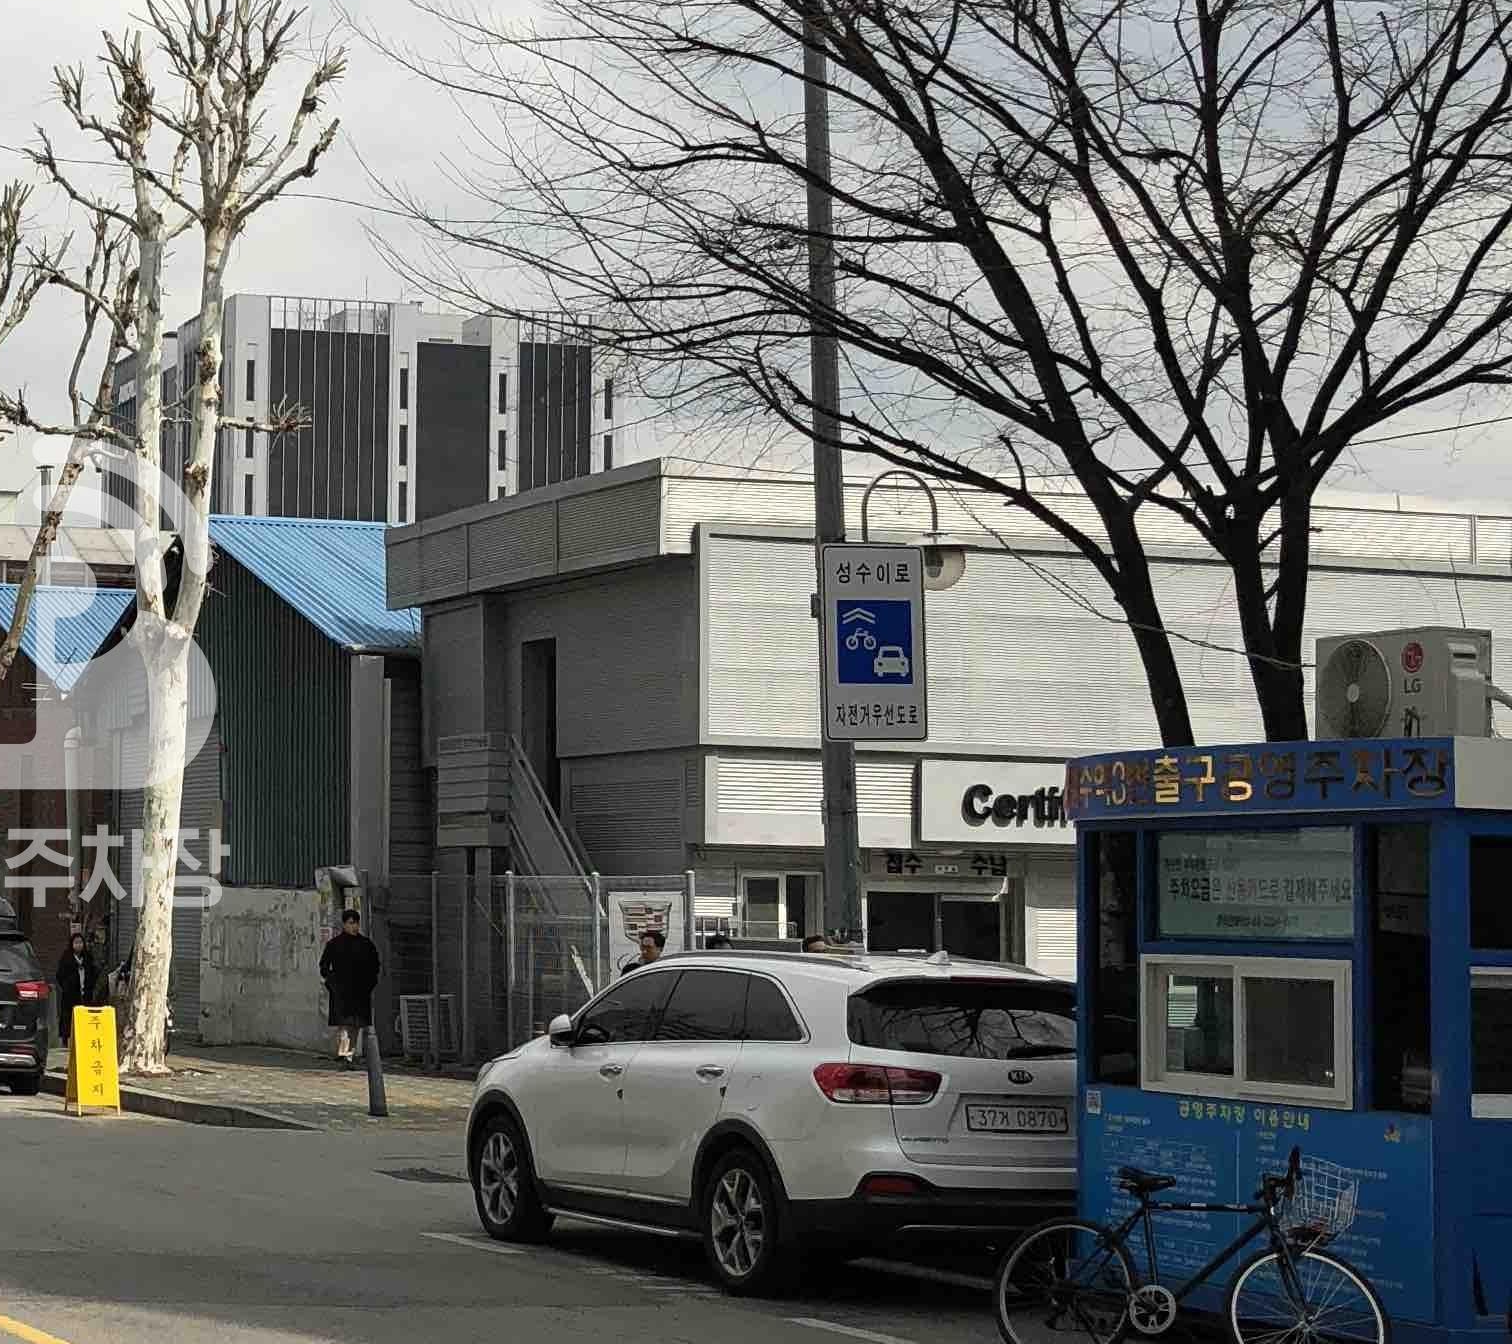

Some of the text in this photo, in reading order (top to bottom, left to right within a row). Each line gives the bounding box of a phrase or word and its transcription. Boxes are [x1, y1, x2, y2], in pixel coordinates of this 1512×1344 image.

[835, 562, 911, 585] 성수이로
[1404, 678, 1422, 694] LG
[835, 704, 919, 727] 자전거우선도로
[88, 1015, 104, 1096] 주차금지
[1016, 1110, 1058, 1128] 0870
